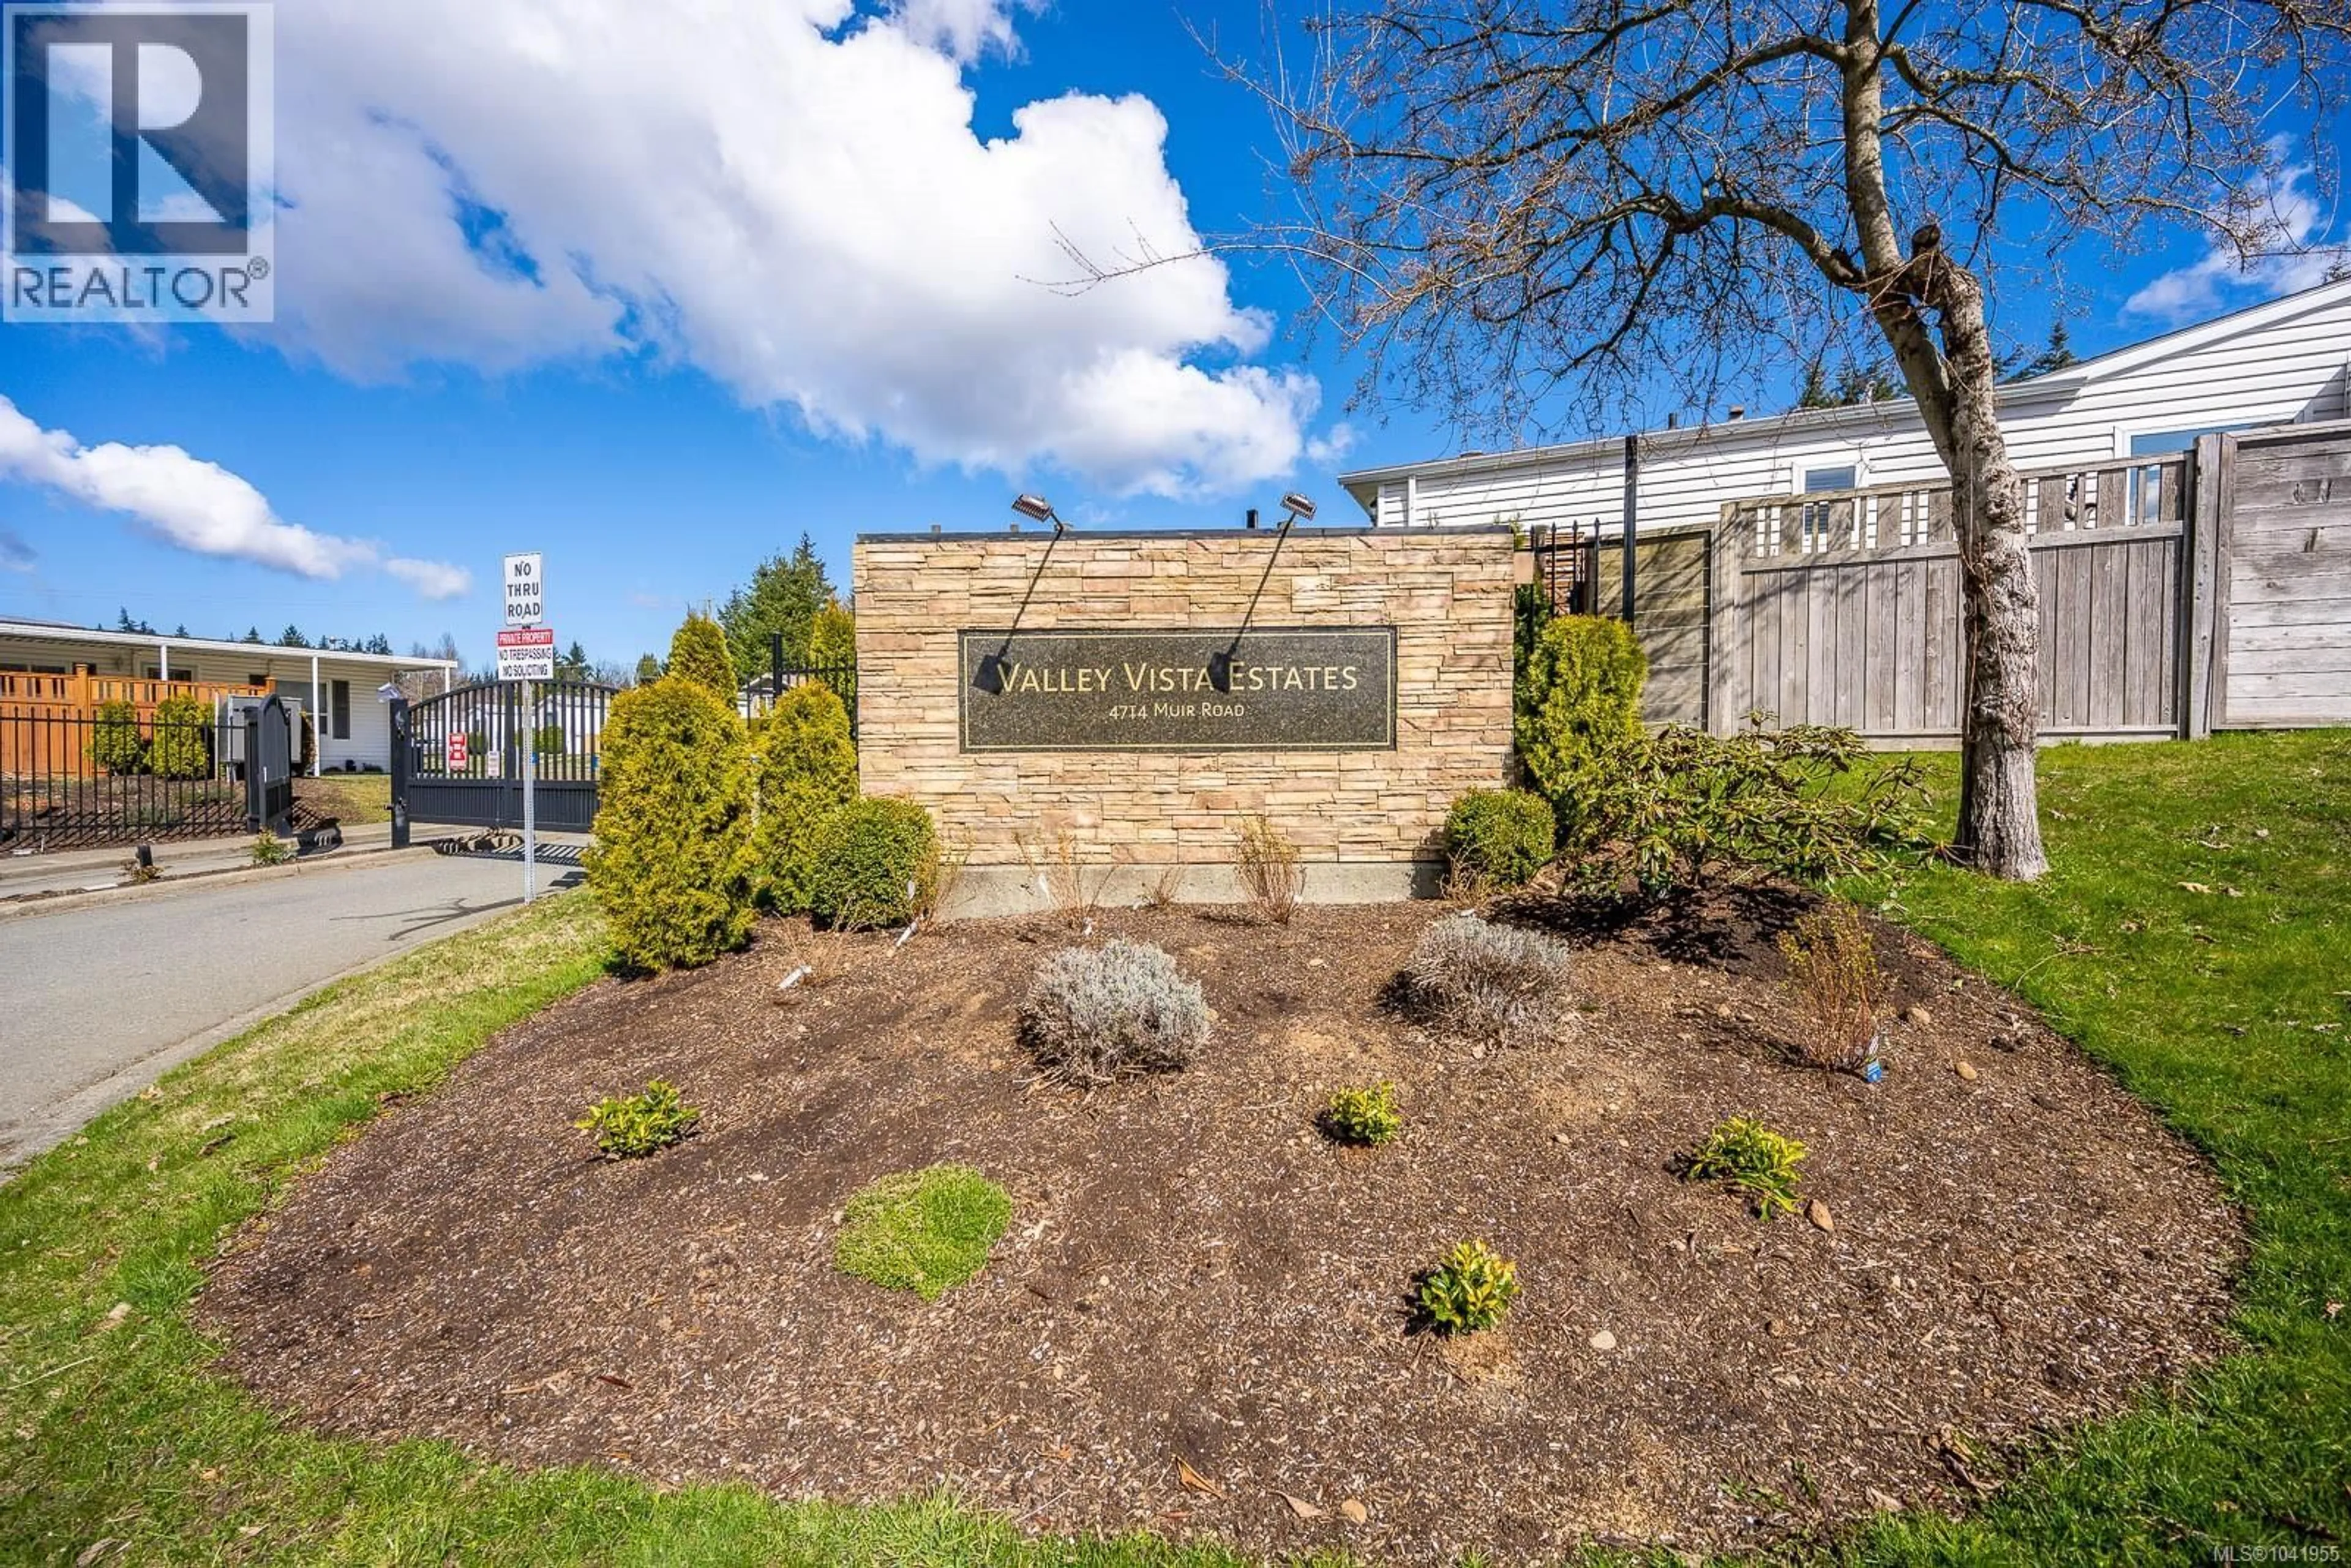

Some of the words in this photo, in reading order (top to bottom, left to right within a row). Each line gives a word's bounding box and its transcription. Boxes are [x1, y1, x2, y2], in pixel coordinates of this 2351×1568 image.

[514, 563, 531, 577] NO
[507, 582, 539, 598] THRU
[508, 602, 540, 617] ROAD
[499, 633, 521, 644] PRIVATE
[522, 631, 551, 643] PROPERTY
[499, 649, 508, 661] NO
[510, 647, 551, 660] TRESPASSING
[503, 665, 512, 677] NO
[514, 664, 547, 676] SOLICITING
[997, 662, 1112, 691] VALLEY
[1124, 662, 1214, 691] VISTA
[1229, 661, 1357, 690] ESTATES
[1154, 703, 1195, 717] MUIR
[1202, 702, 1244, 717] ROAD
